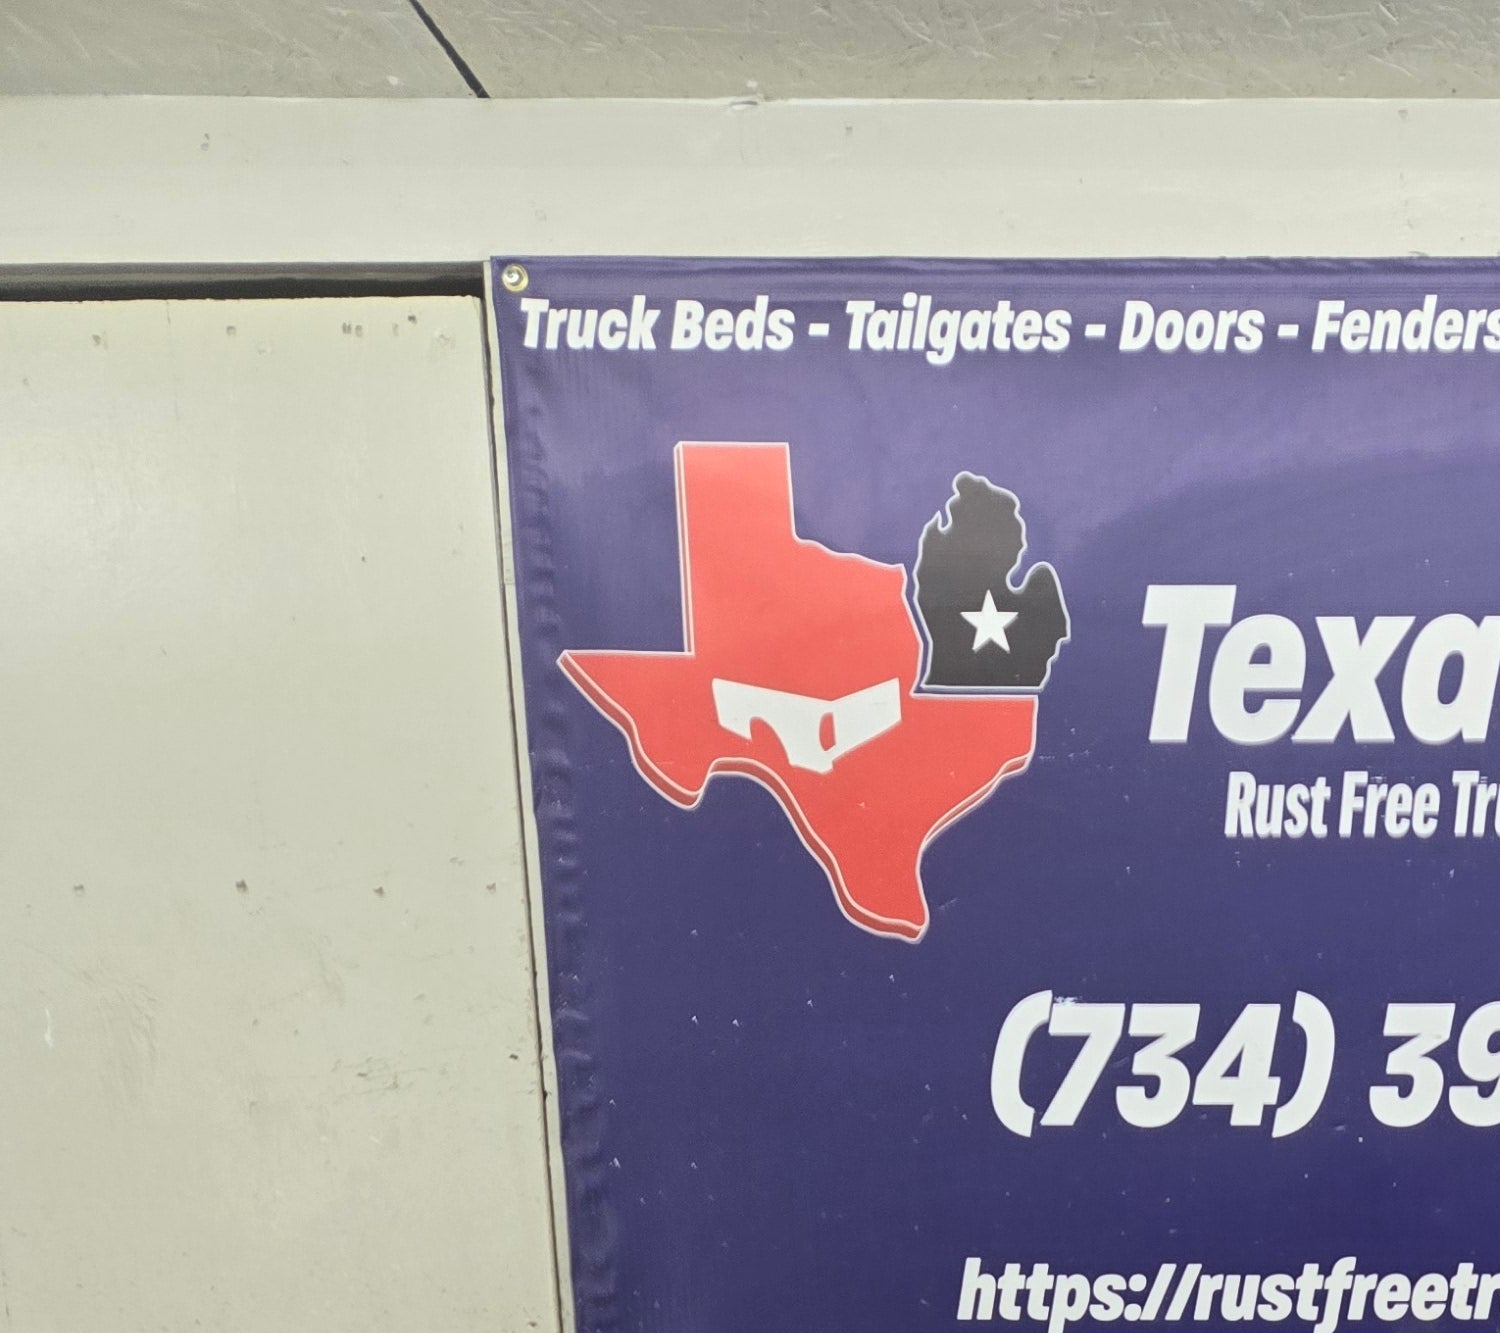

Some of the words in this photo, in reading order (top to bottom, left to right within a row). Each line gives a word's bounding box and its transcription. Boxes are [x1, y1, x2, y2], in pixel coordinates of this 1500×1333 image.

[518, 293, 663, 353] Truck
[668, 293, 797, 354] Beds
[806, 321, 831, 339] -
[844, 290, 1074, 369] Tailgates
[1083, 322, 1108, 340] -
[1117, 298, 1267, 355] Doors
[1275, 322, 1301, 341] -
[1223, 770, 1333, 840] Rust
[1337, 769, 1442, 840] Free
[989, 988, 1337, 1139] (734)
